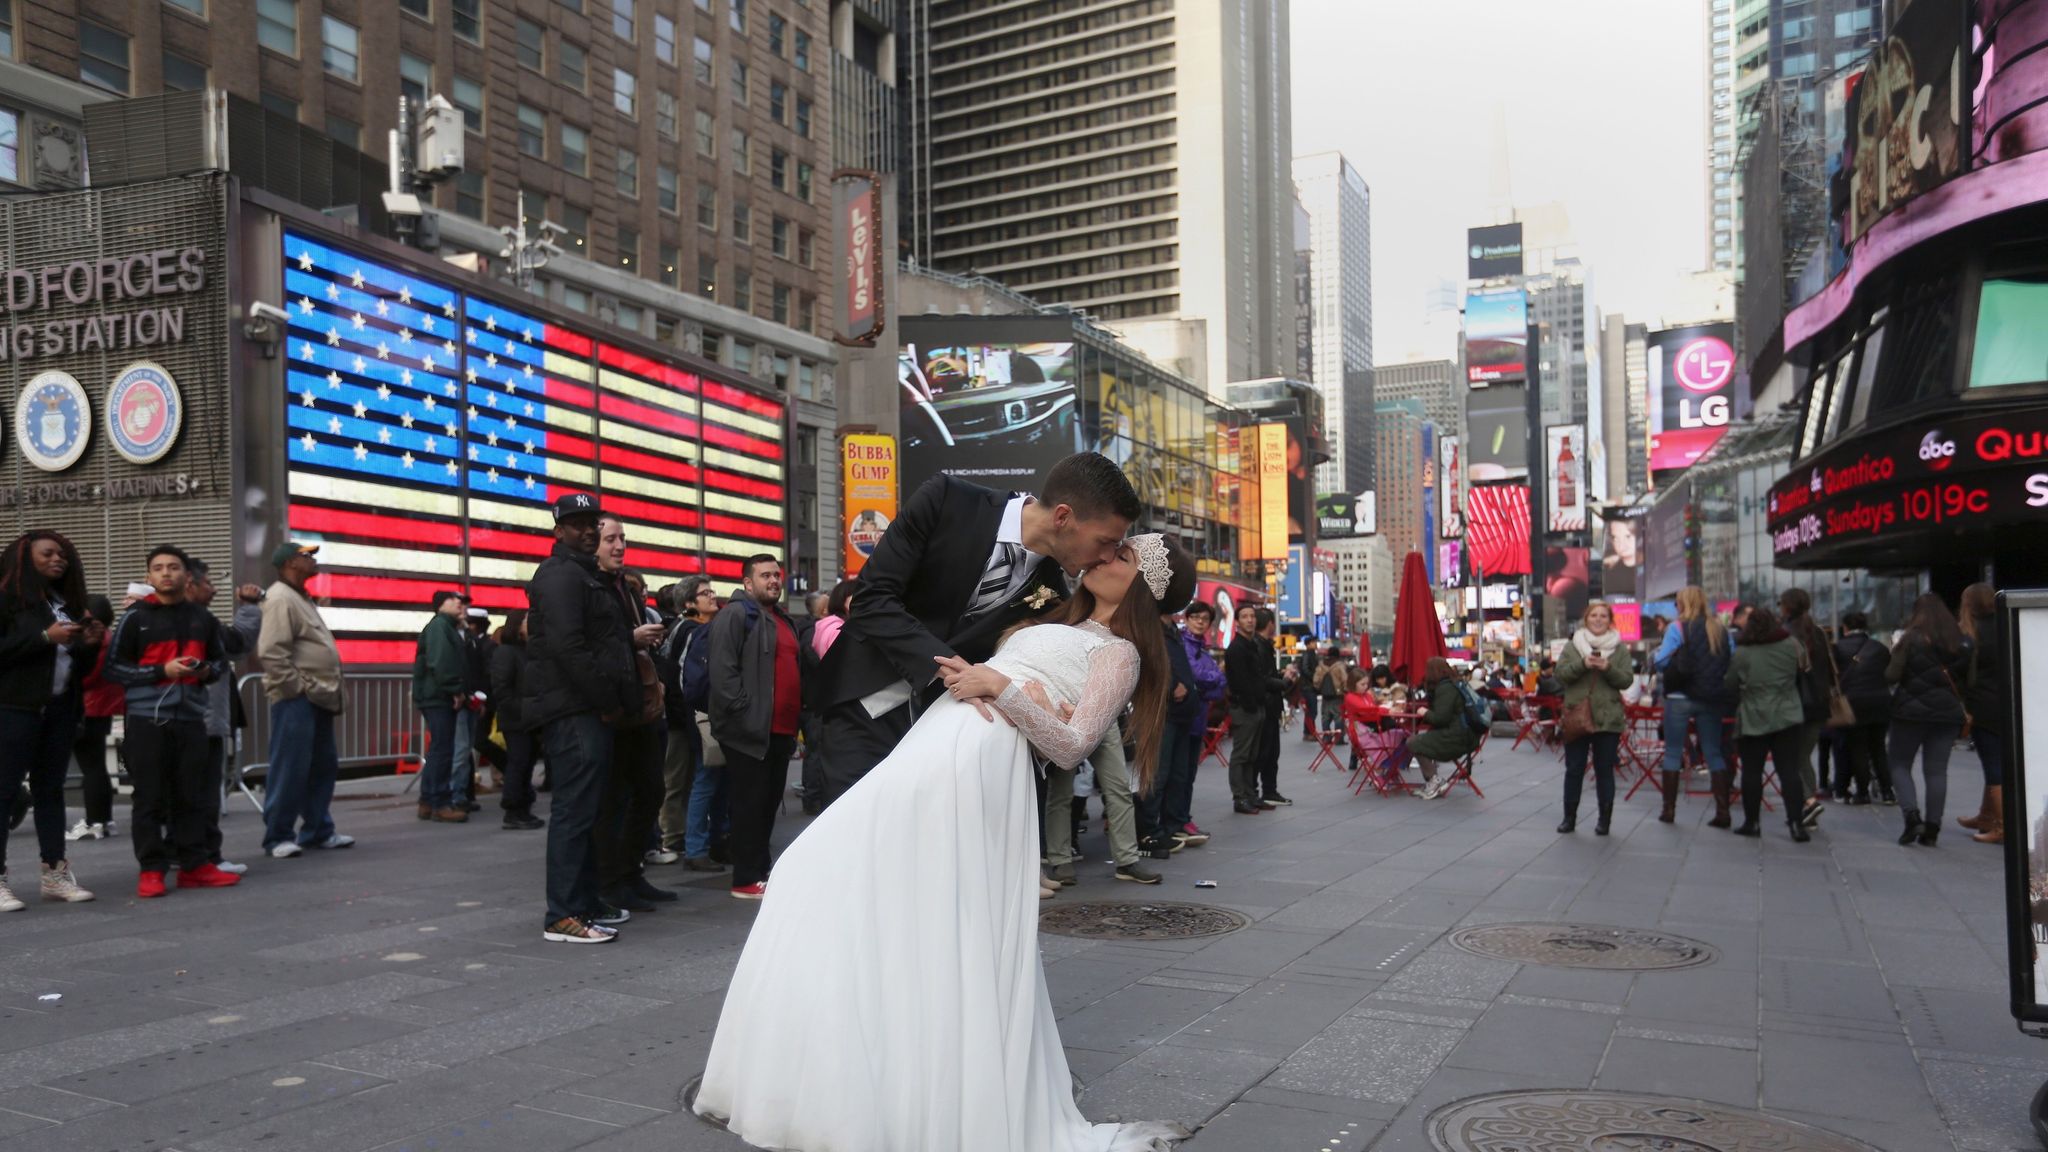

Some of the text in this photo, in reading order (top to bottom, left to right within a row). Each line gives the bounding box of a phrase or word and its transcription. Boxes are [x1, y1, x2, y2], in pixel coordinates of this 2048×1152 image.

[0, 246, 205, 311] D FORCES
[1295, 274, 1309, 349] TIMES
[43, 307, 184, 356] STATION
[1679, 395, 1729, 428] LG
[848, 442, 892, 460] BUBBA
[1824, 453, 1894, 496] Quantico
[1918, 439, 1956, 460] abc
[1975, 428, 2048, 461] Qu
[27, 481, 88, 503] FORCE
[107, 473, 188, 498] MARINES
[851, 463, 890, 480] GUMP
[1826, 502, 1896, 536] Sundays
